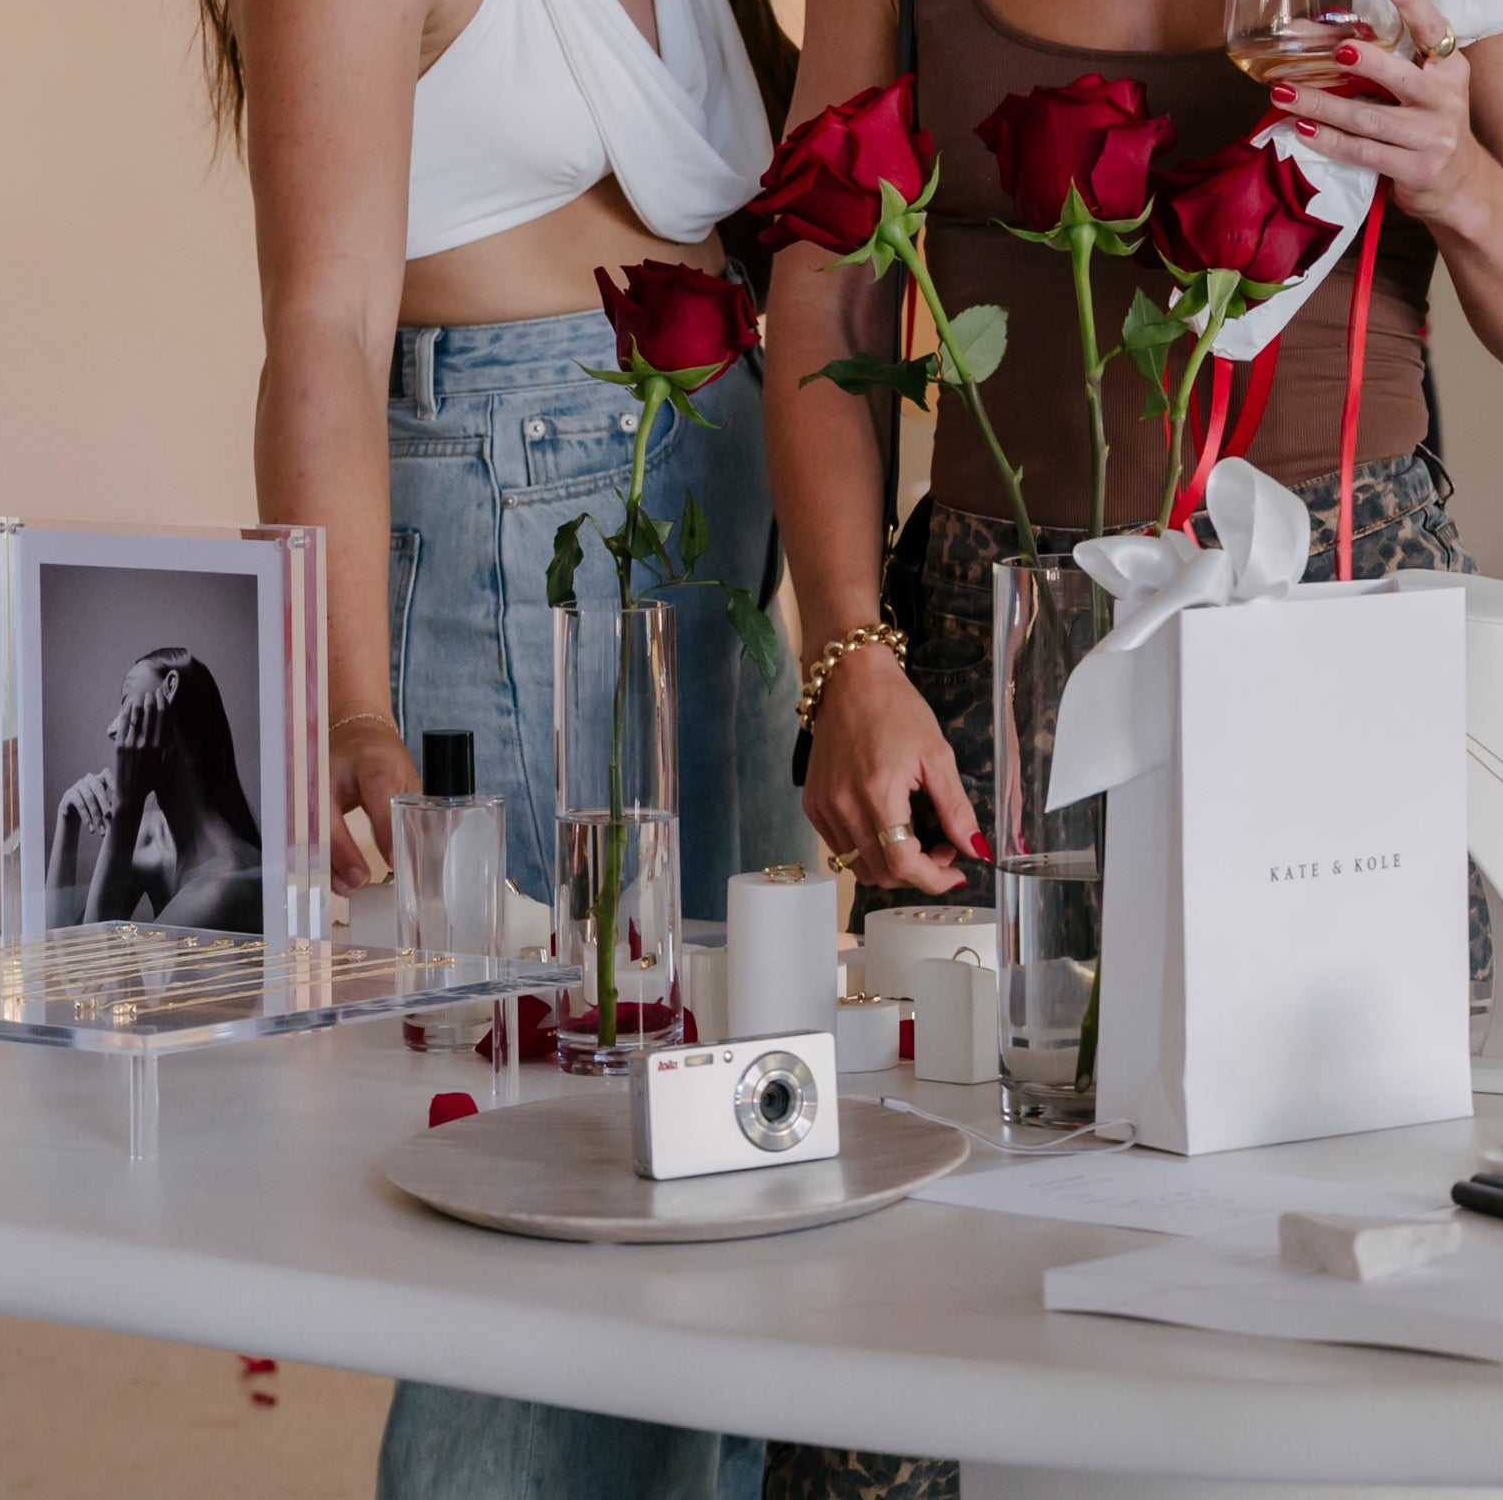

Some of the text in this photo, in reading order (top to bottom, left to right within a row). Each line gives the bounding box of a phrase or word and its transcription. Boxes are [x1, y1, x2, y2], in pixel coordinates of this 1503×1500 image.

[1269, 852, 1402, 882] KATE & KOLE
